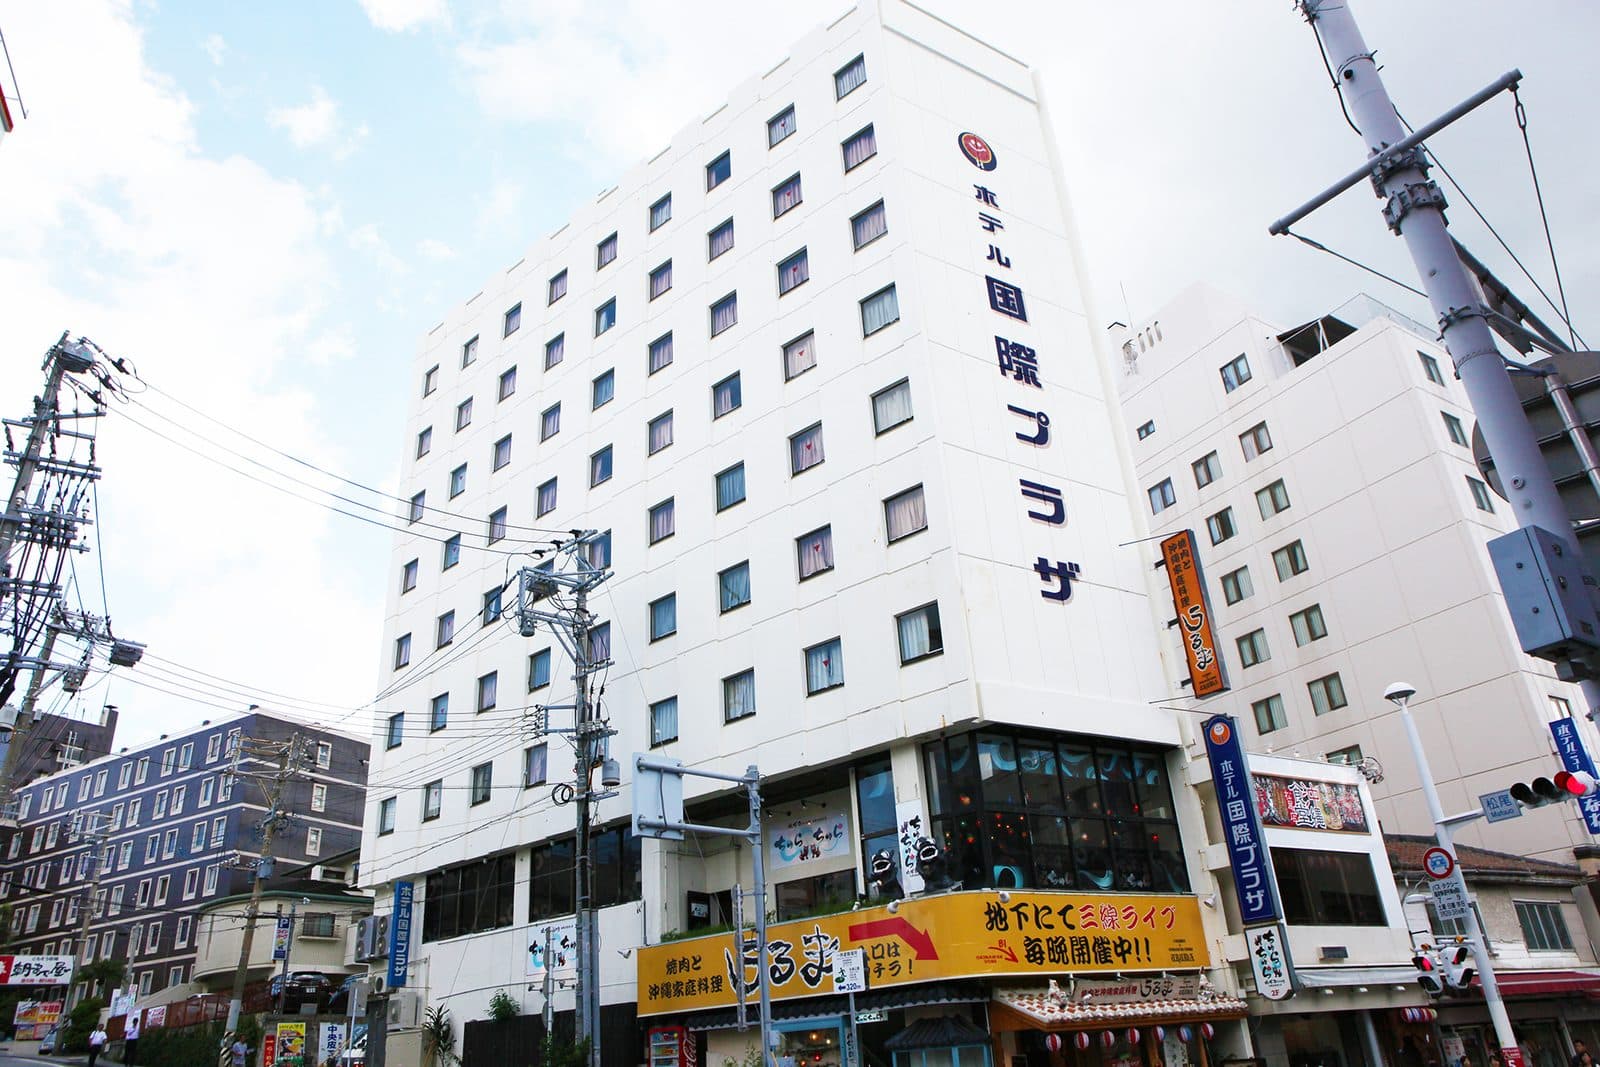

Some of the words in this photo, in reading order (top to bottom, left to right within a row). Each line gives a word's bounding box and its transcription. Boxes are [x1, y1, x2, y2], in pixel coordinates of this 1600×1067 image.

[974, 183, 1079, 602] ホテル国際プラザ
[1486, 794, 1513, 810] 松尾
[1220, 760, 1265, 911] ホテル国際プラザ
[984, 902, 1176, 931] 地下にて三線ライブ
[394, 886, 412, 977] ホテル国際プラザ
[665, 956, 702, 975] 焼肉と
[648, 975, 723, 1001] 沖縄家庭料理
